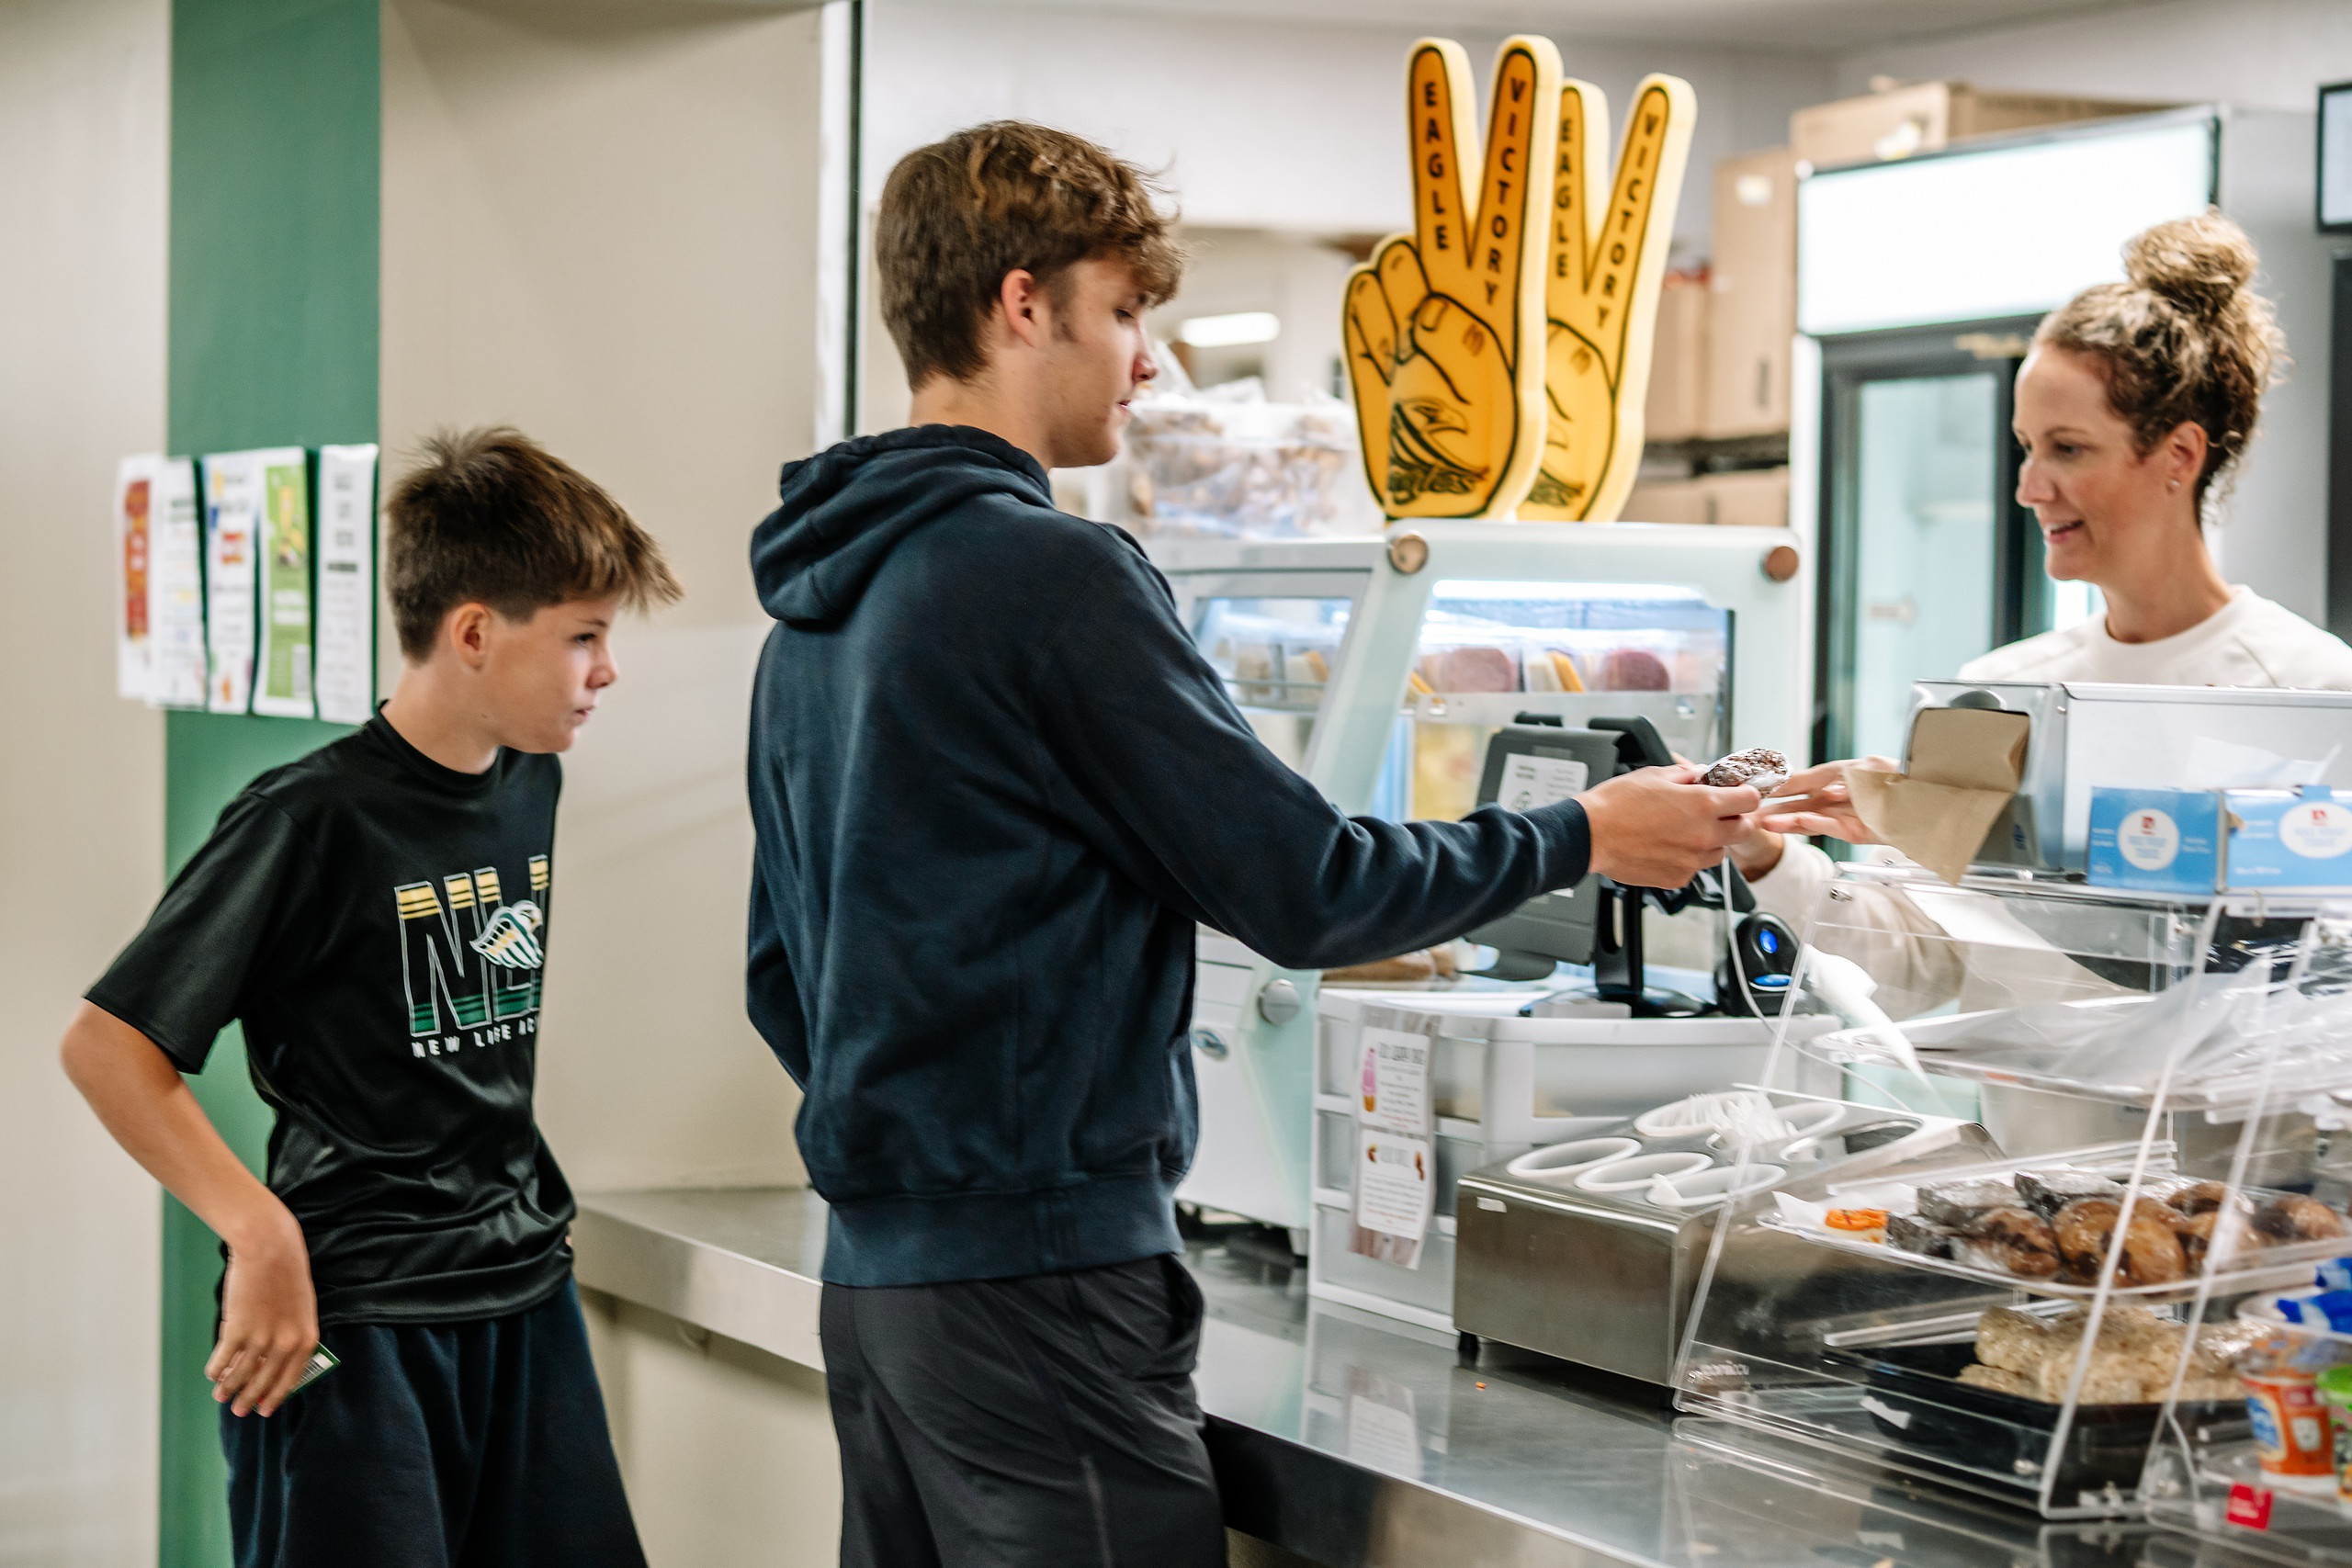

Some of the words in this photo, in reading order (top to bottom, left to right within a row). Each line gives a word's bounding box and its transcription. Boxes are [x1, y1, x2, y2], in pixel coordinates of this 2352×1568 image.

[1423, 81, 1449, 251] EAGLE
[1484, 76, 1527, 306] VICTORY
[1555, 118, 1574, 278] EAGLE
[1596, 112, 1659, 329] VICTORY
[411, 1035, 460, 1058] NEW
[473, 1023, 512, 1048] LIFE
